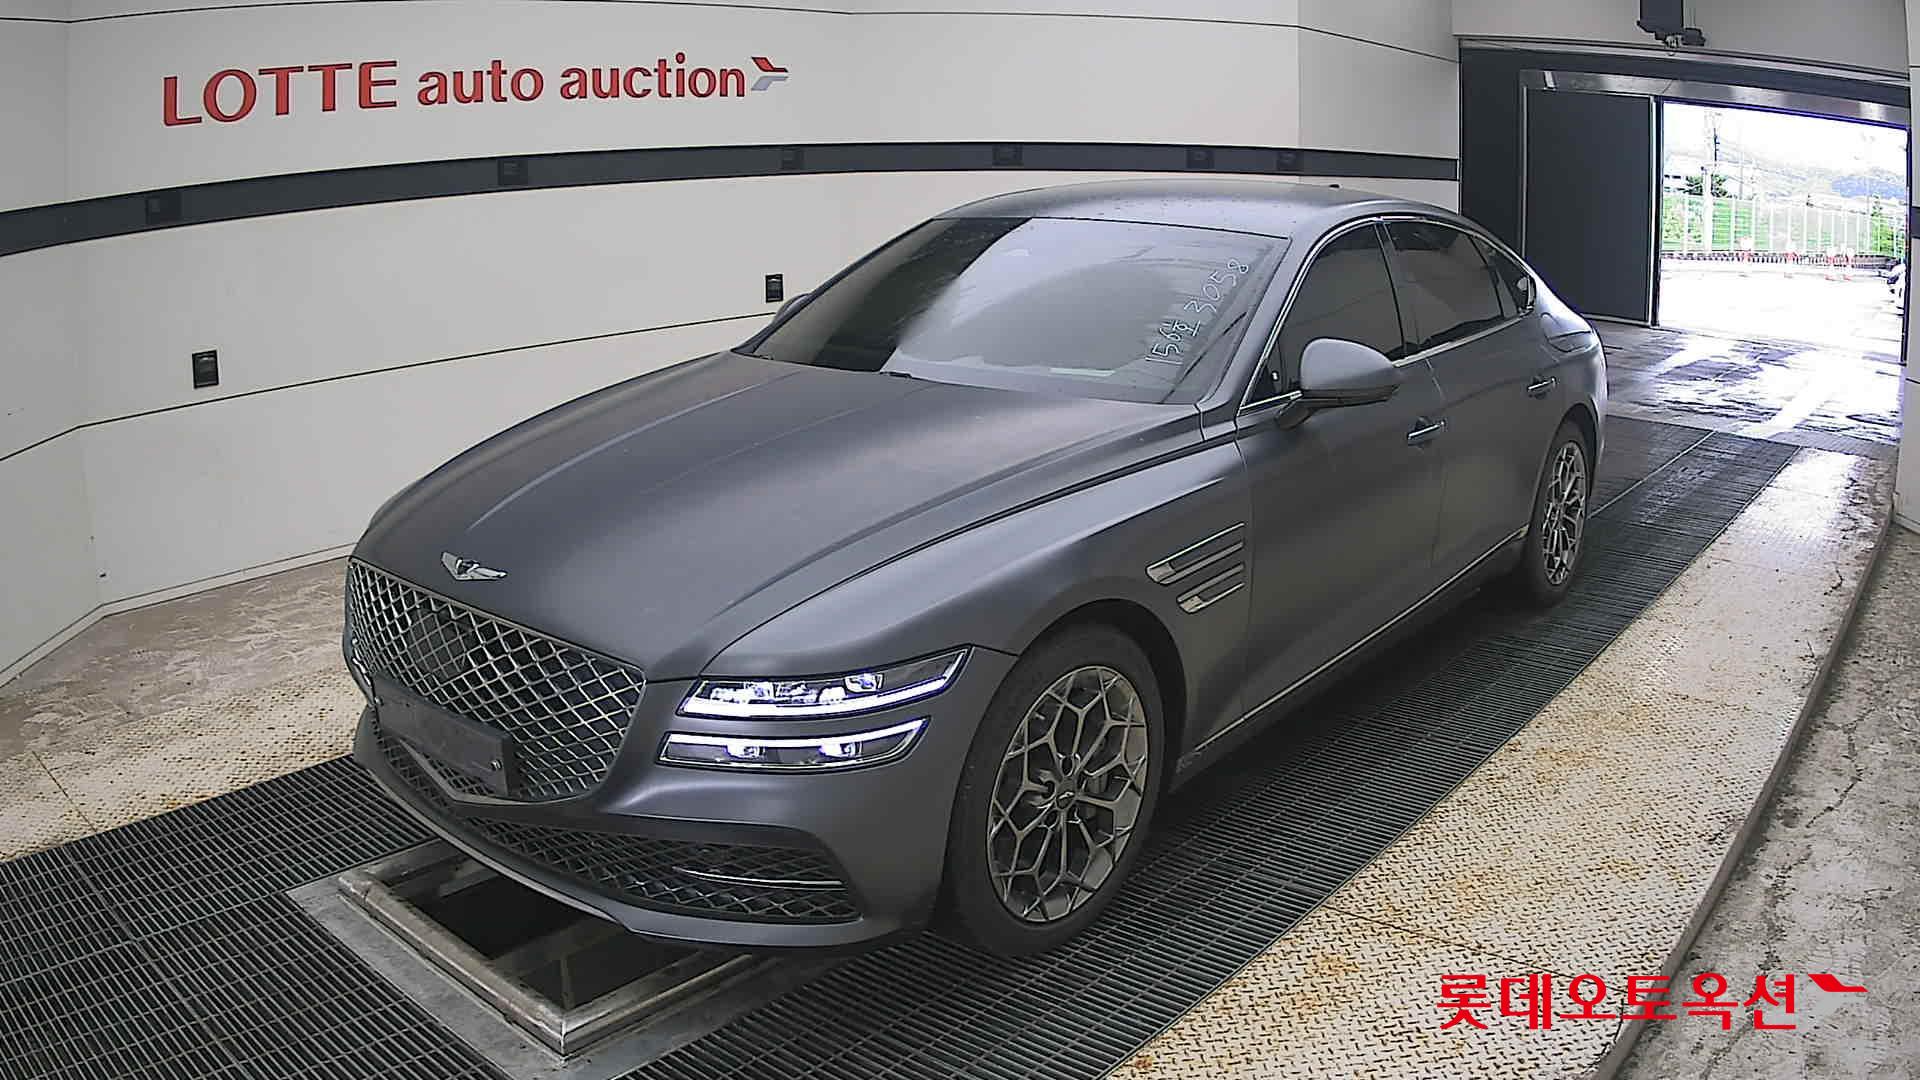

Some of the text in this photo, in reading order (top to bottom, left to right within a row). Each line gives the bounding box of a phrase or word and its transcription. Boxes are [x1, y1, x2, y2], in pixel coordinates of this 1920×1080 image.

[163, 51, 746, 126] LOTTE auto auction
[1183, 258, 1249, 312] 3058
